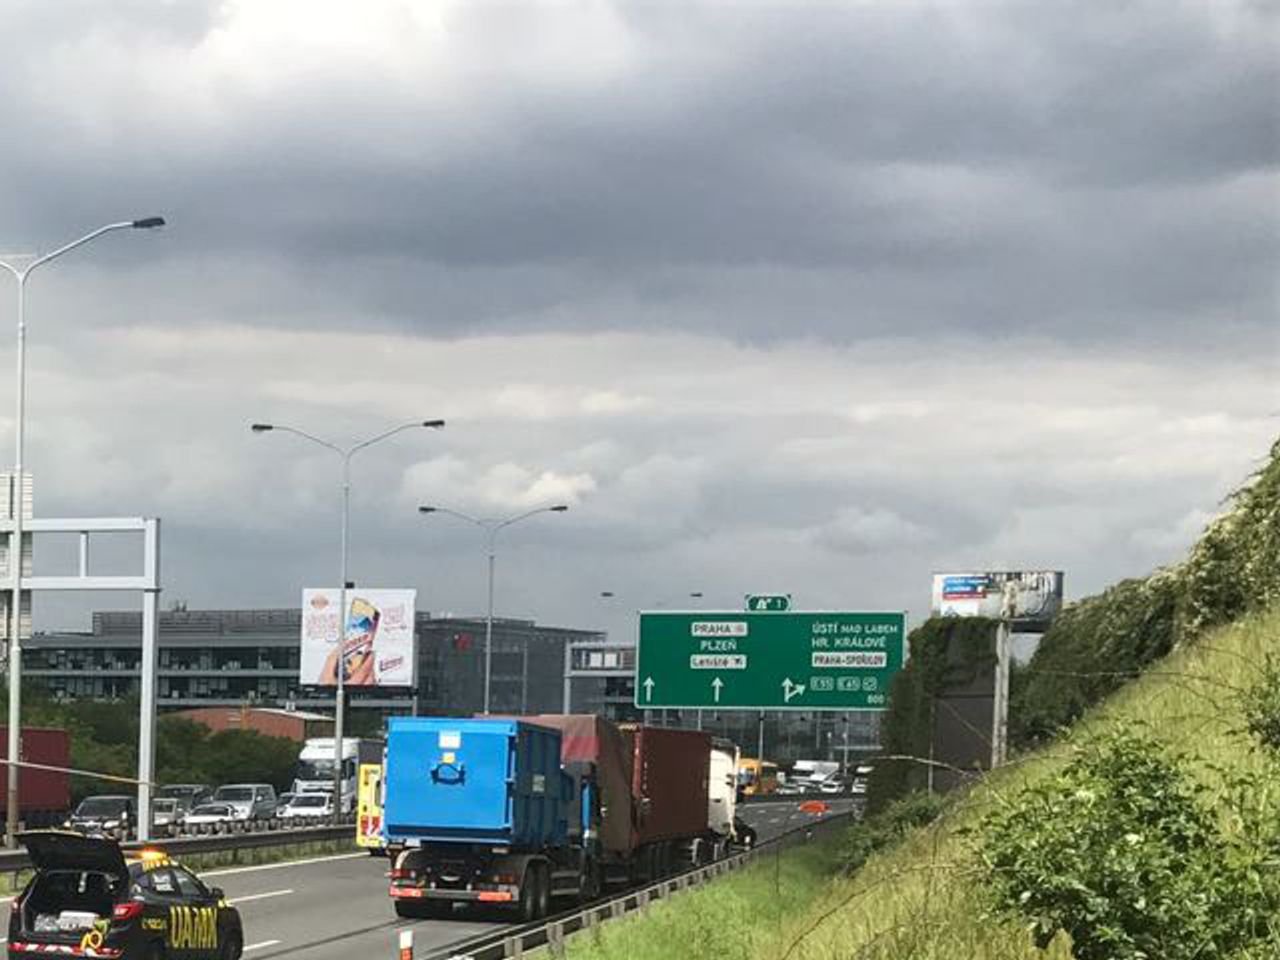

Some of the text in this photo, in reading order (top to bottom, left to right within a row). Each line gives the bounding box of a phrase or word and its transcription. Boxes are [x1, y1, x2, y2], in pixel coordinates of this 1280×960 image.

[694, 623, 731, 633] PRAHA
[812, 621, 898, 634] ÚSTÍ NAD LABEM
[700, 638, 737, 651] PLZEŇ
